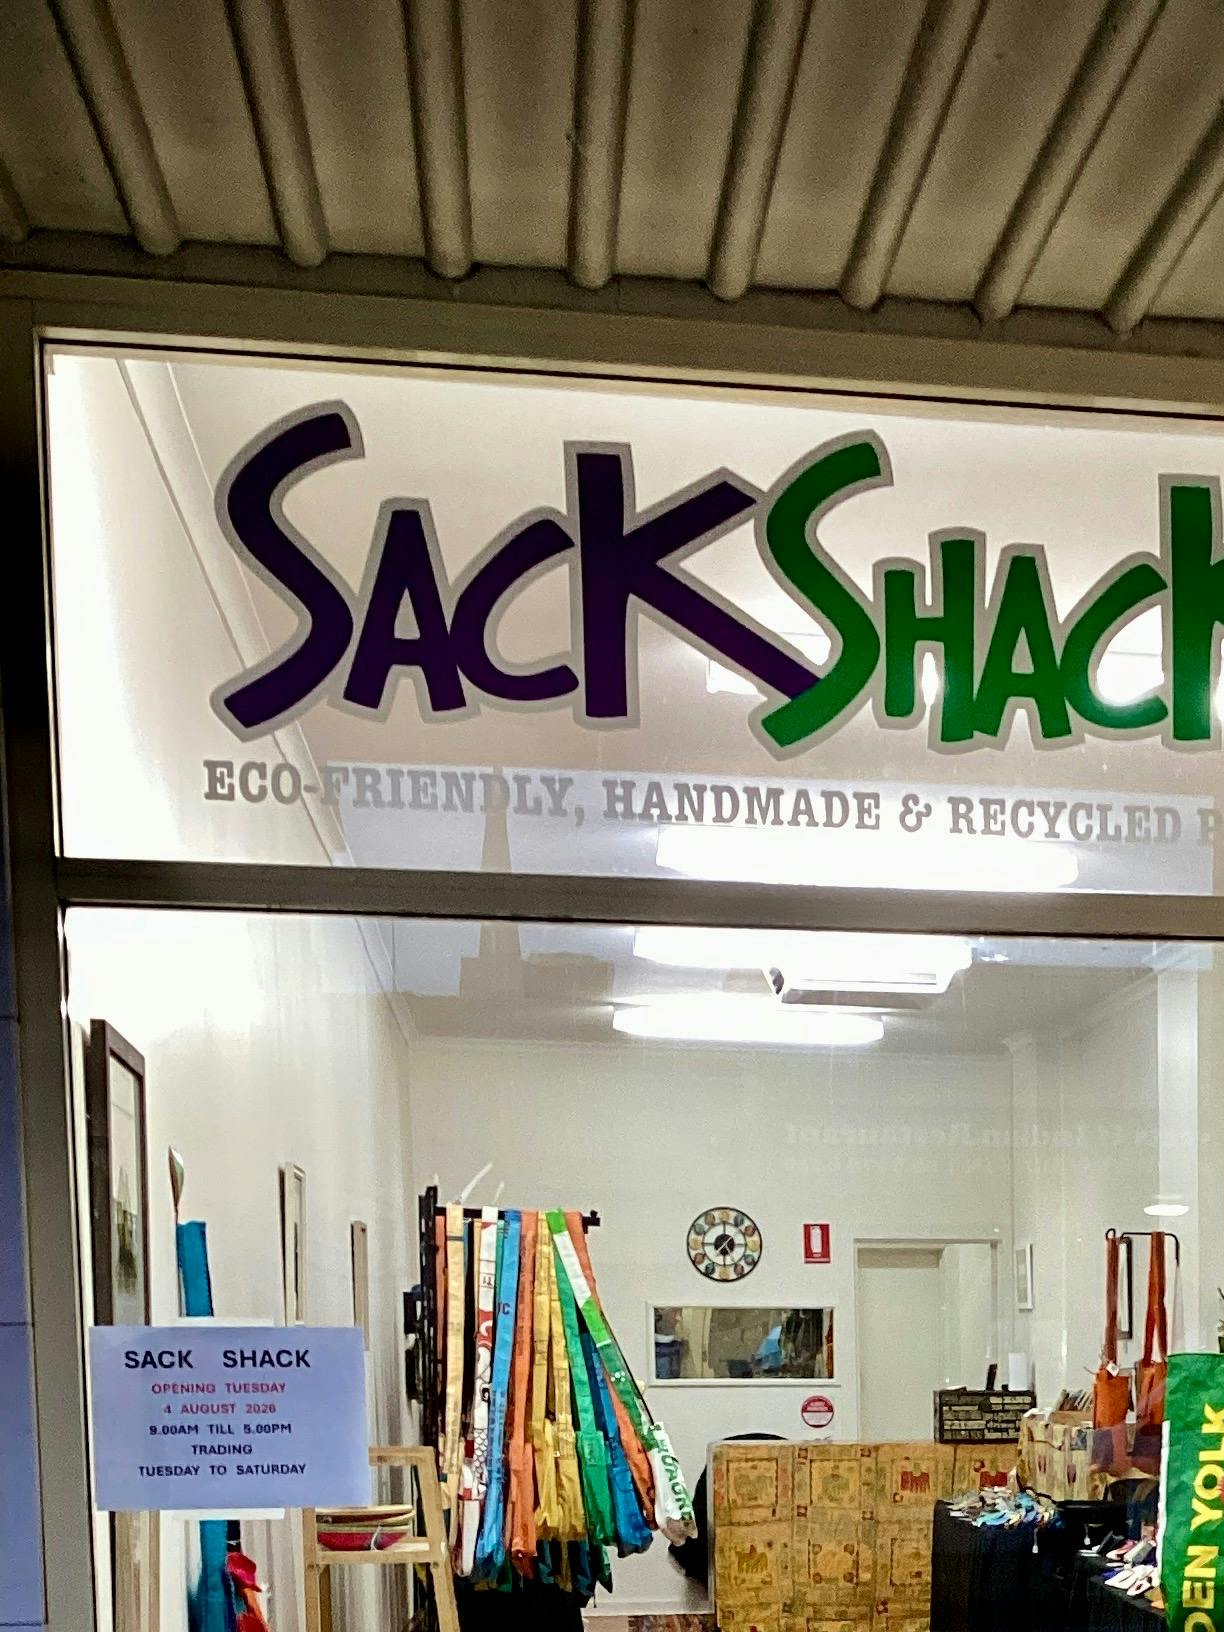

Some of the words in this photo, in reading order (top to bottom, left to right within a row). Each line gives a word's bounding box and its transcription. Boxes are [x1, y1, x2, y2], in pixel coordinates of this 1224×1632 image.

[203, 758, 587, 828] ECO-FRIENDLY,
[602, 776, 881, 830] HANDMADE
[898, 793, 934, 832] &
[948, 795, 1183, 845] RECYCLED
[124, 1349, 194, 1369] SACK
[222, 1348, 312, 1369] SHACK
[151, 1383, 216, 1395] OPENING
[224, 1382, 287, 1394] TUESDAY
[163, 1403, 172, 1414] 4
[180, 1403, 236, 1415] AUGUST
[207, 1423, 235, 1435] TILL
[191, 1444, 253, 1456] TRADING
[138, 1465, 201, 1477] TUESDAY
[209, 1465, 227, 1476] TO
[236, 1463, 307, 1476] SATURDAY
